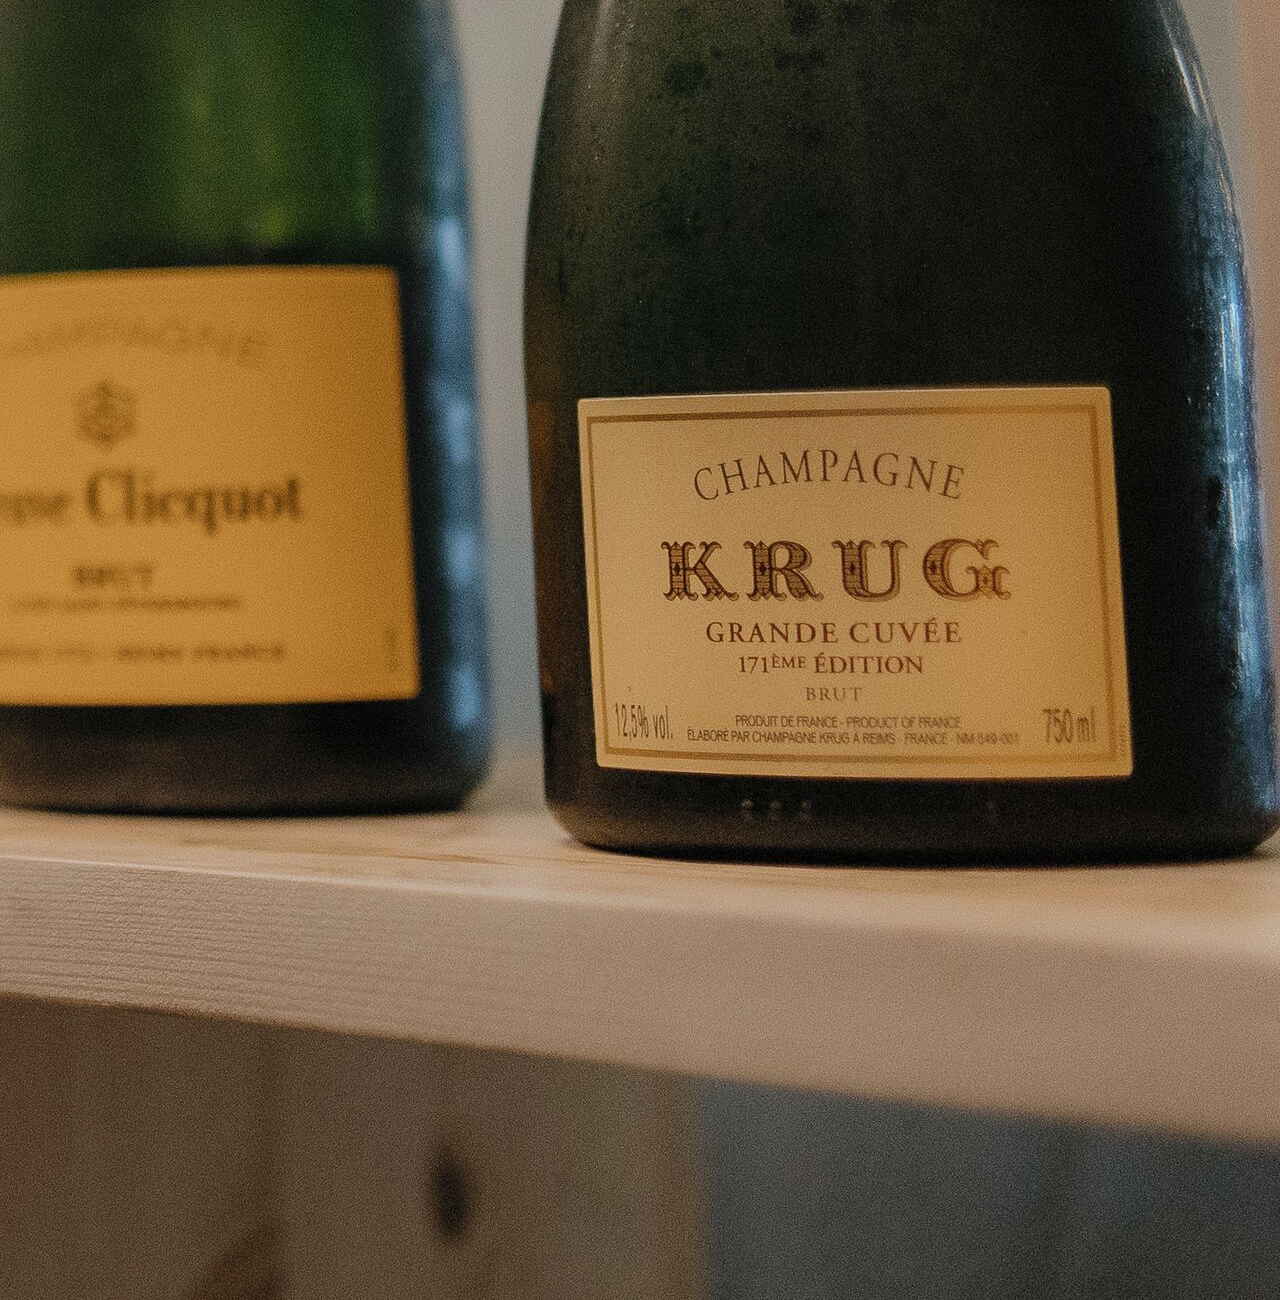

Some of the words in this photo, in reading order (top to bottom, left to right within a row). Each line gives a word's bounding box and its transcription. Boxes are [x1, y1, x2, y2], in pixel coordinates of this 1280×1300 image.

[693, 449, 965, 501] CHAMPAGNE
[85, 467, 305, 538] Clicquot
[660, 538, 1012, 601] KRUG
[706, 621, 838, 644] GRANDE
[849, 617, 961, 644] CUVÉE
[813, 651, 924, 675] ÉDITION
[805, 686, 862, 701] BRUT
[614, 702, 649, 742] 12,5%
[653, 705, 674, 739] vol.
[687, 728, 729, 742] ÉLABORÉ
[731, 731, 750, 742] PAR
[752, 731, 817, 744] CHAMPAGNE
[819, 732, 850, 745] KRUG
[863, 732, 897, 745] REIMS
[903, 732, 947, 745] FRANCE
[735, 715, 778, 728] PRODUIT
[781, 715, 794, 728] DE
[797, 716, 838, 729] FRANCE
[846, 716, 899, 729] PRODUCT
[901, 716, 916, 729] OF
[918, 716, 961, 729] FRANCE
[1042, 708, 1073, 743] 750
[1077, 709, 1096, 743] ml
